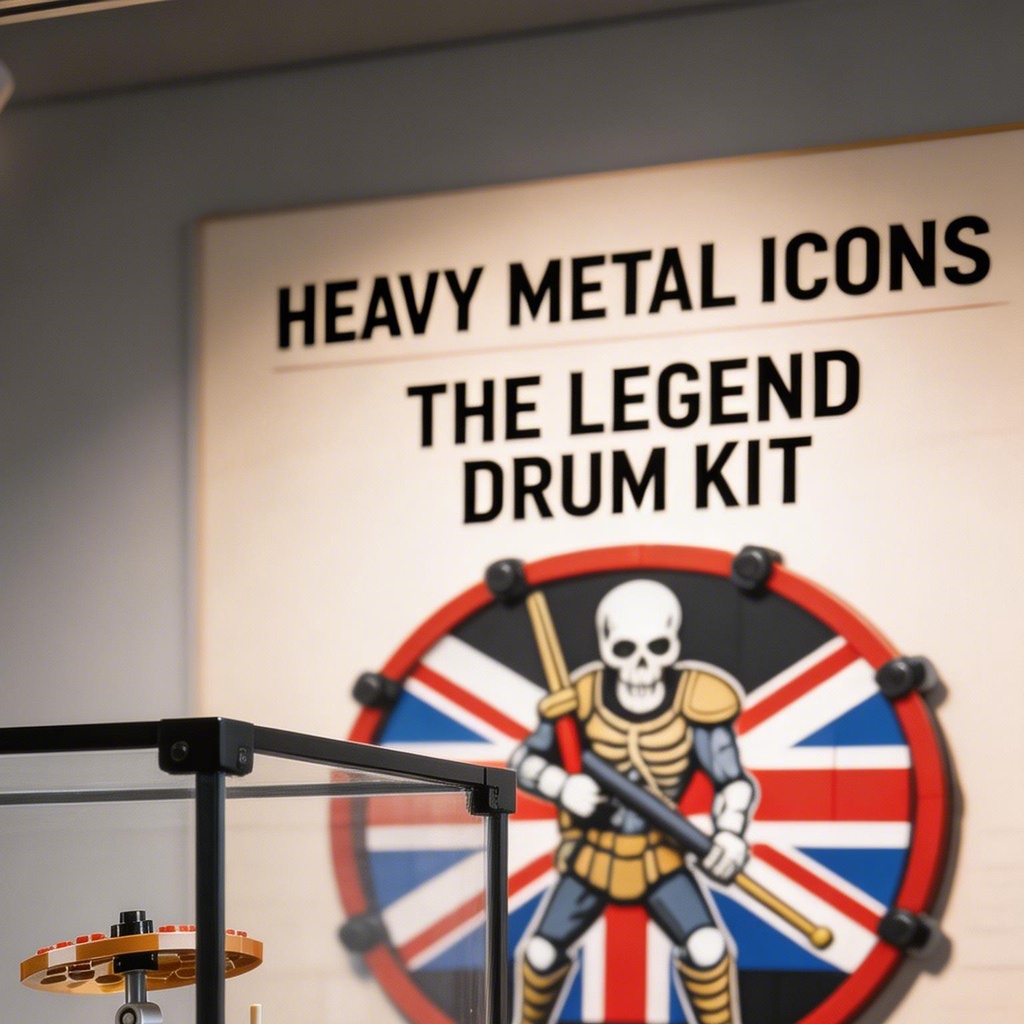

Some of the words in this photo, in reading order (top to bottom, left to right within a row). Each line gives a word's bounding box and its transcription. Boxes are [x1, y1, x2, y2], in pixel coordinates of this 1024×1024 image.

[276, 266, 485, 351] HEAVY
[509, 243, 736, 327] METAL
[761, 214, 992, 304] ICONS
[406, 375, 542, 449] THE
[570, 349, 861, 436] LEGEND
[463, 447, 667, 525] DRUM
[695, 435, 812, 510] KIT
